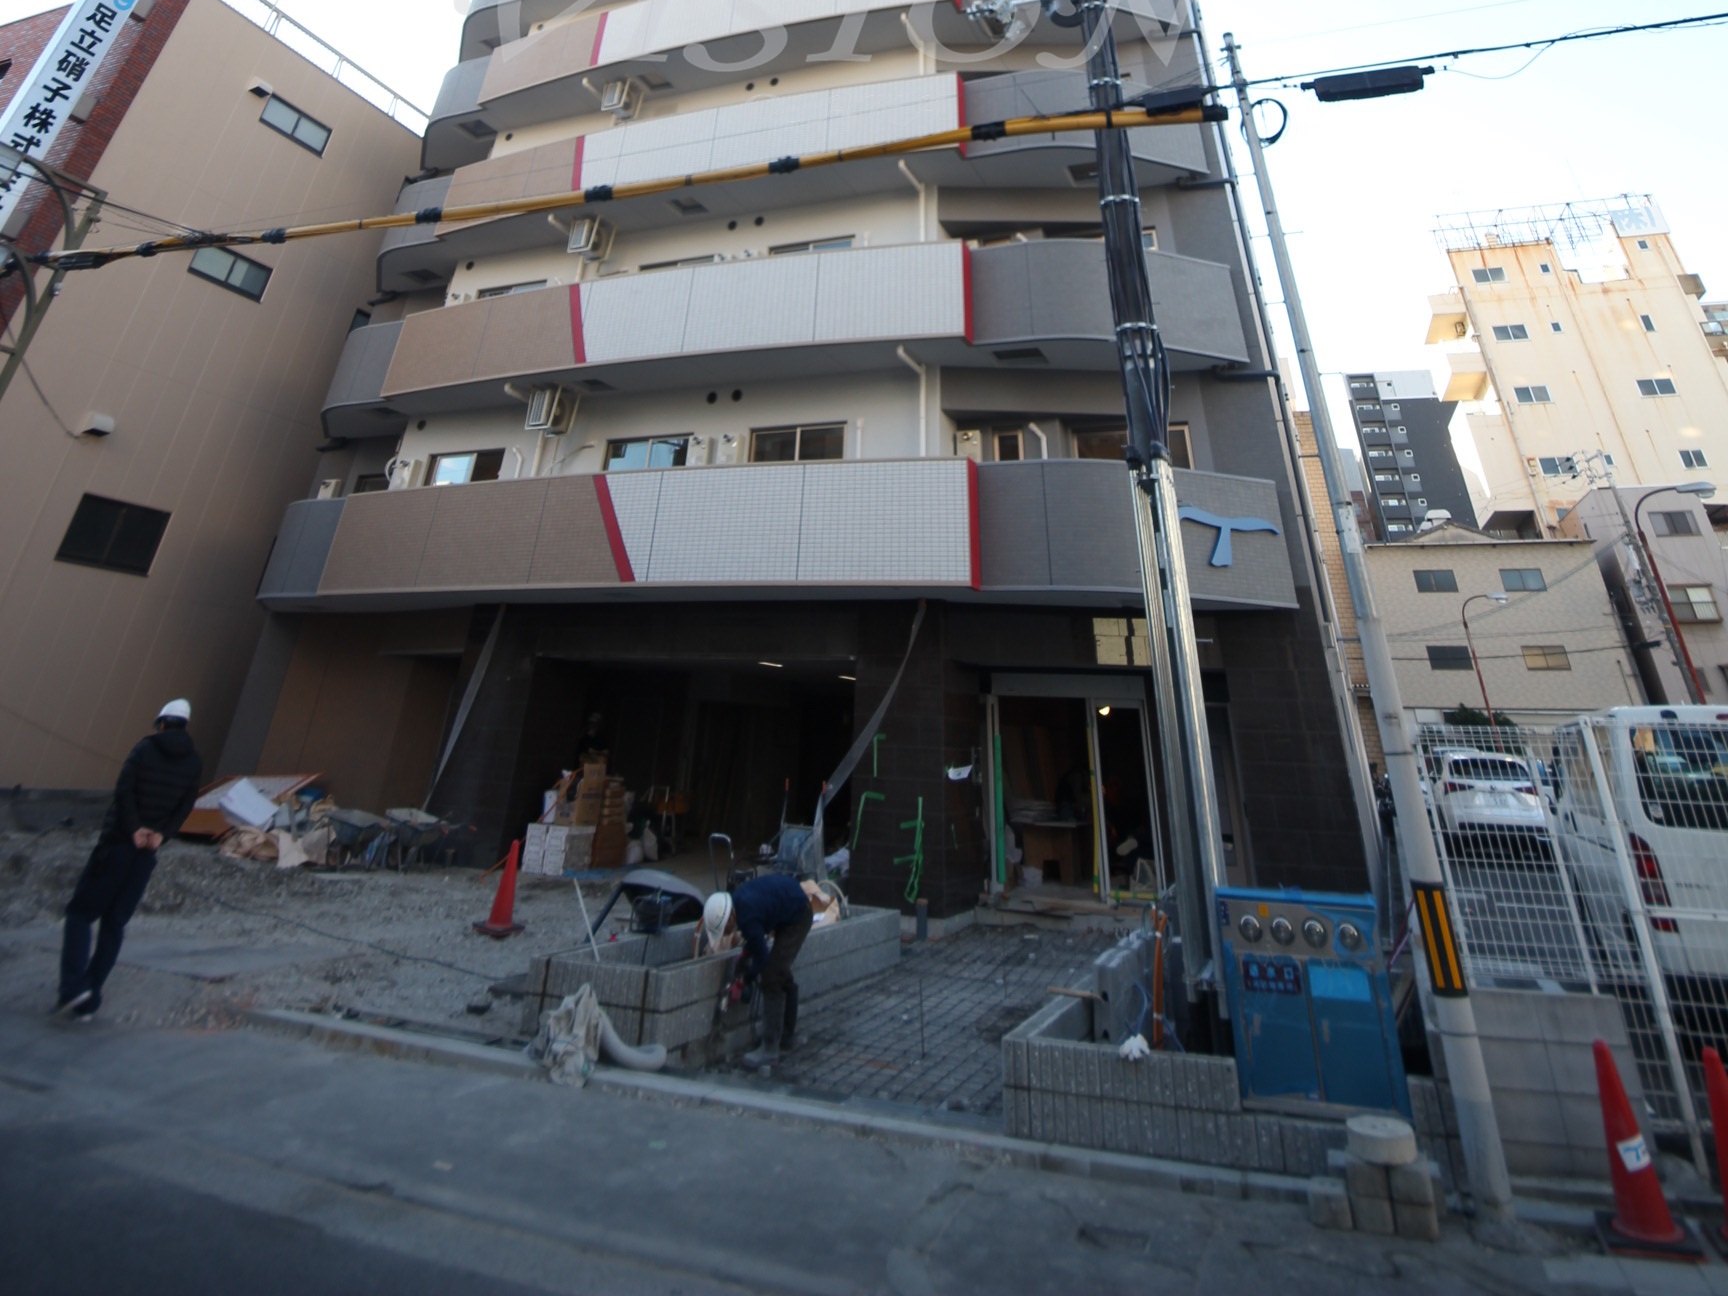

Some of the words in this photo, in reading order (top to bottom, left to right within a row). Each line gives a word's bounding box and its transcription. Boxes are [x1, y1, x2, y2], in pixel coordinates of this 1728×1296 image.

[0, 2, 117, 210] 足立硝子株式
